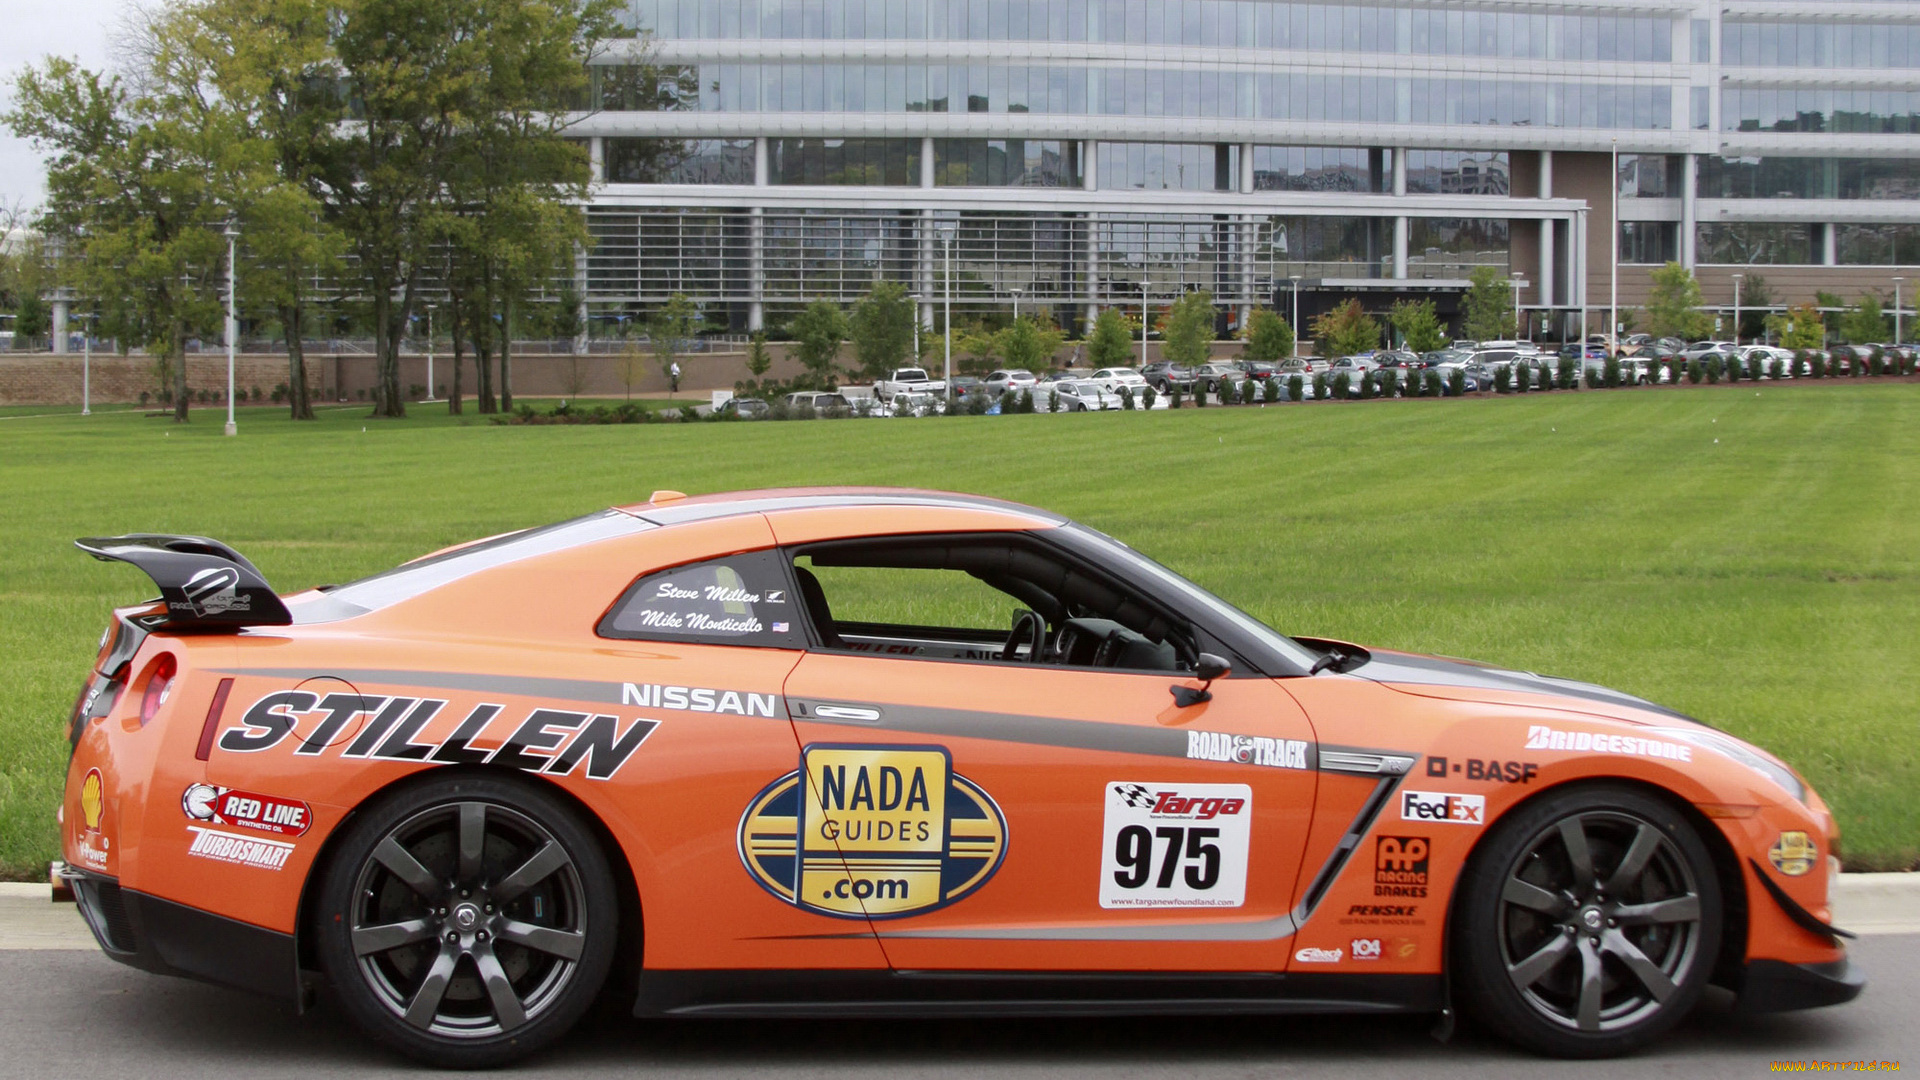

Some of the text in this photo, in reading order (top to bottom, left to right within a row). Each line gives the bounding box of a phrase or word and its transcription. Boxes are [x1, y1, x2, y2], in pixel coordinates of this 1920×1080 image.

[656, 583, 760, 603] Steve Millen
[640, 610, 763, 633] Mike Monticello
[622, 682, 776, 718] NISSAN
[218, 690, 662, 780] STILLEN
[1525, 725, 1692, 762] BRIDGESTONE
[1467, 759, 1538, 784] BASF
[822, 764, 930, 812] NADA
[223, 796, 262, 820] RED
[1151, 792, 1245, 820] Targa
[1403, 792, 1481, 822] FedEx
[236, 819, 272, 831] SYNTHETIC
[820, 819, 930, 842] GUIDES
[187, 825, 296, 868] TURBOSMART
[1113, 824, 1221, 890] 975
[1378, 837, 1428, 871] AP
[188, 851, 282, 871] PERFORMANCE PRODUCTS
[823, 878, 909, 899] .com
[1376, 870, 1426, 885] RACING
[1111, 898, 1235, 907] www.targanewfoundland.com
[1374, 885, 1429, 898] BRAKES
[1348, 905, 1418, 916] PENSKE
[1351, 939, 1381, 956] 104
